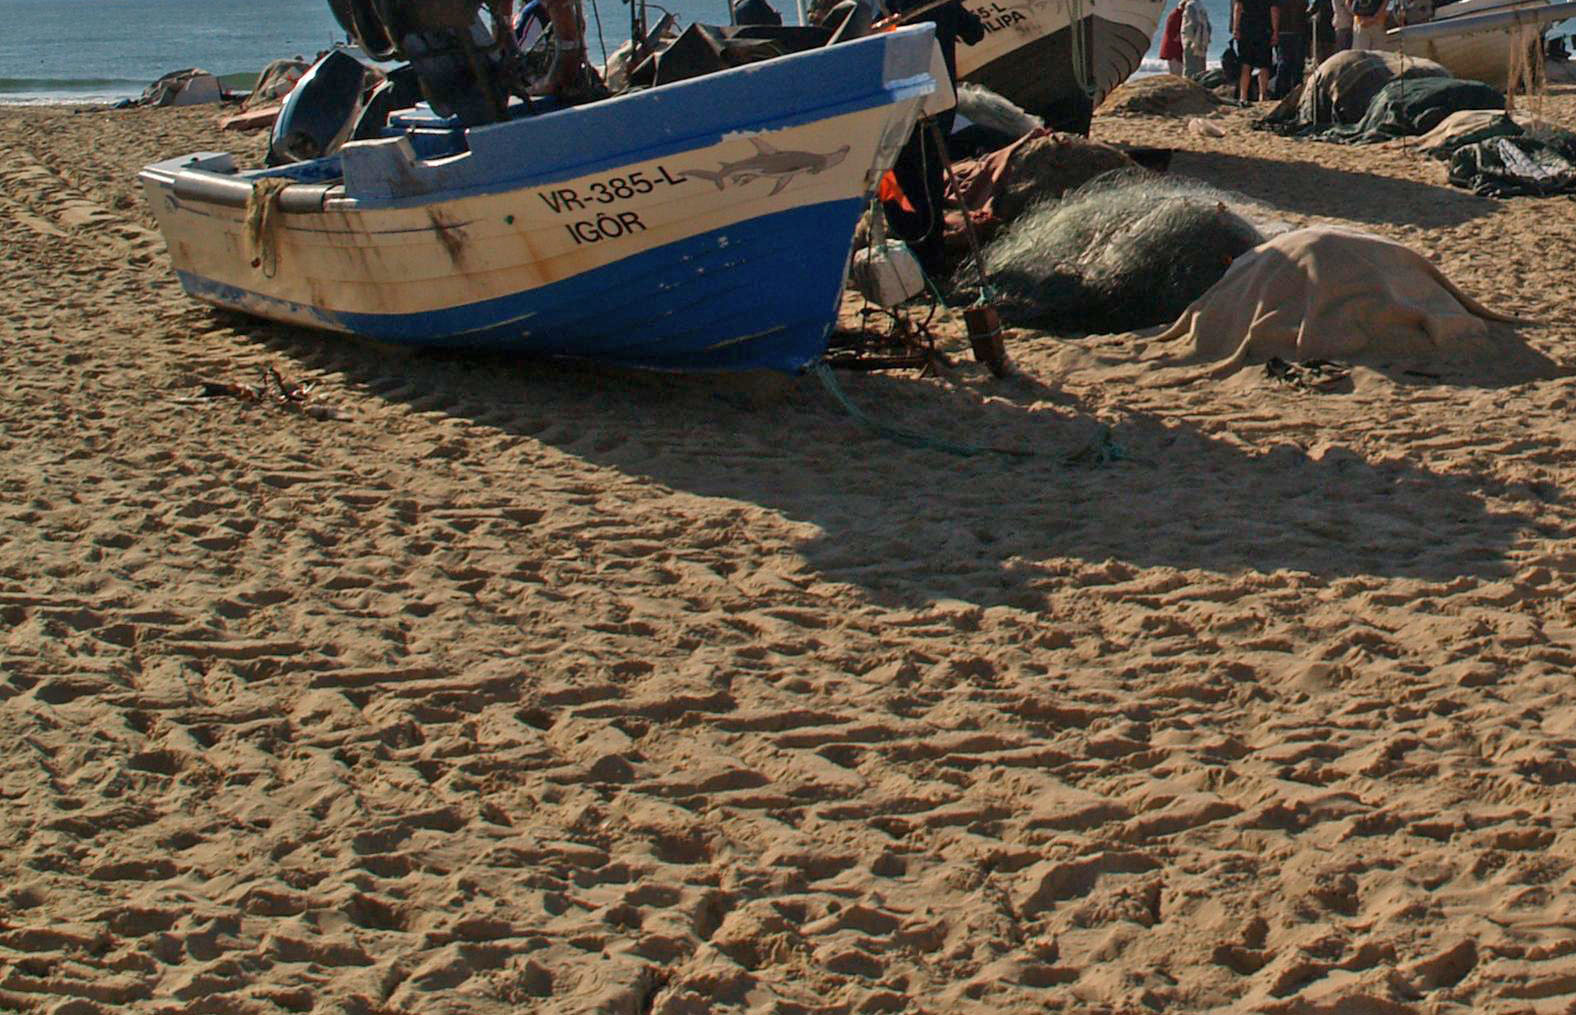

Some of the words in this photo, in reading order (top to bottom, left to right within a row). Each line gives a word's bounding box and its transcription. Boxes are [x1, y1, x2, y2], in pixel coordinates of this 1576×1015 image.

[983, 11, 1026, 33] ILIPA
[537, 165, 688, 214] VR-385-L
[565, 211, 648, 245] IGÔR
